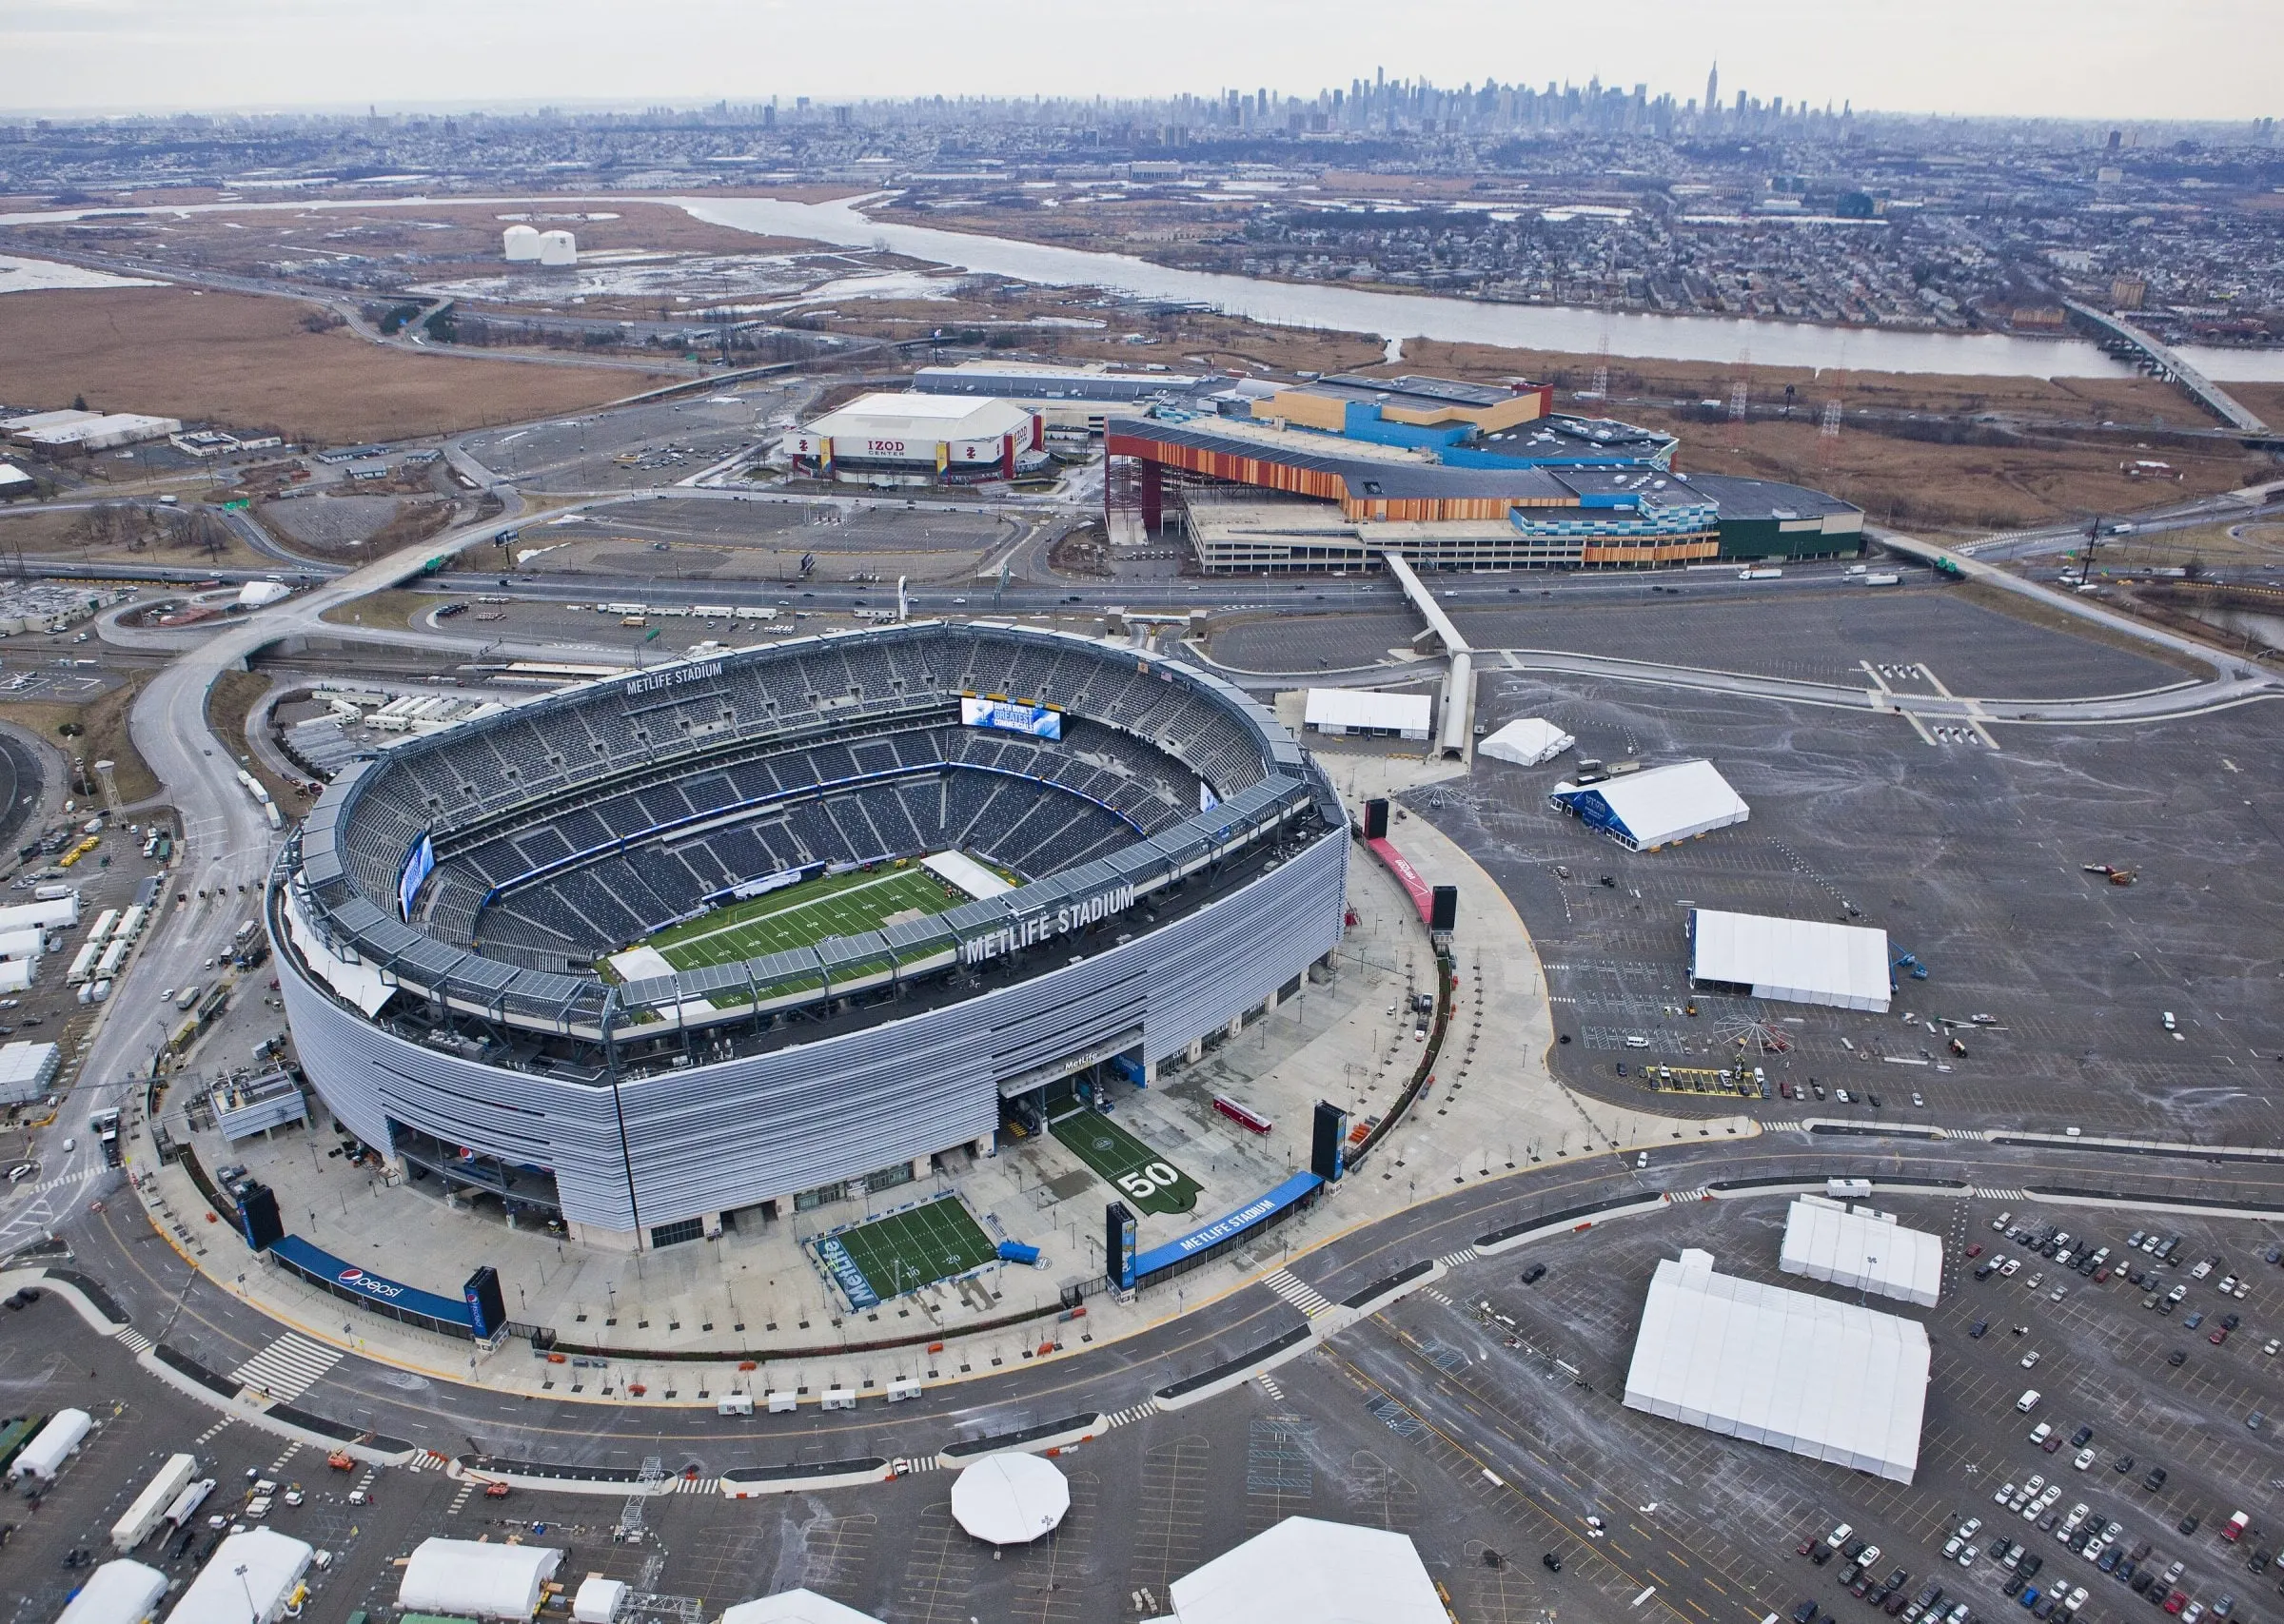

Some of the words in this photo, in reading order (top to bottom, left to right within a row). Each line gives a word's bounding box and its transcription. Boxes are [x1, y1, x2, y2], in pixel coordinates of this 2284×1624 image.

[868, 440, 904, 451] IZOD
[626, 673, 673, 695] METLIFE
[675, 662, 722, 684] STADIUM
[994, 702, 1013, 712] SUPER
[994, 710, 1034, 725] GREATEST
[994, 719, 1034, 732] COMMERCIALS
[967, 915, 1052, 965] METLIFE
[1057, 884, 1135, 934] STADIUM
[1065, 1052, 1098, 1070] MetLife
[1172, 1047, 1188, 1059] CLUB
[1117, 1163, 1178, 1198] 50
[1180, 1223, 1232, 1251] METLIFE
[1228, 1200, 1275, 1227] STADIUM
[946, 1254, 961, 1264] 20
[822, 1241, 875, 1302] MetLife
[352, 1277, 404, 1298] pepsi
